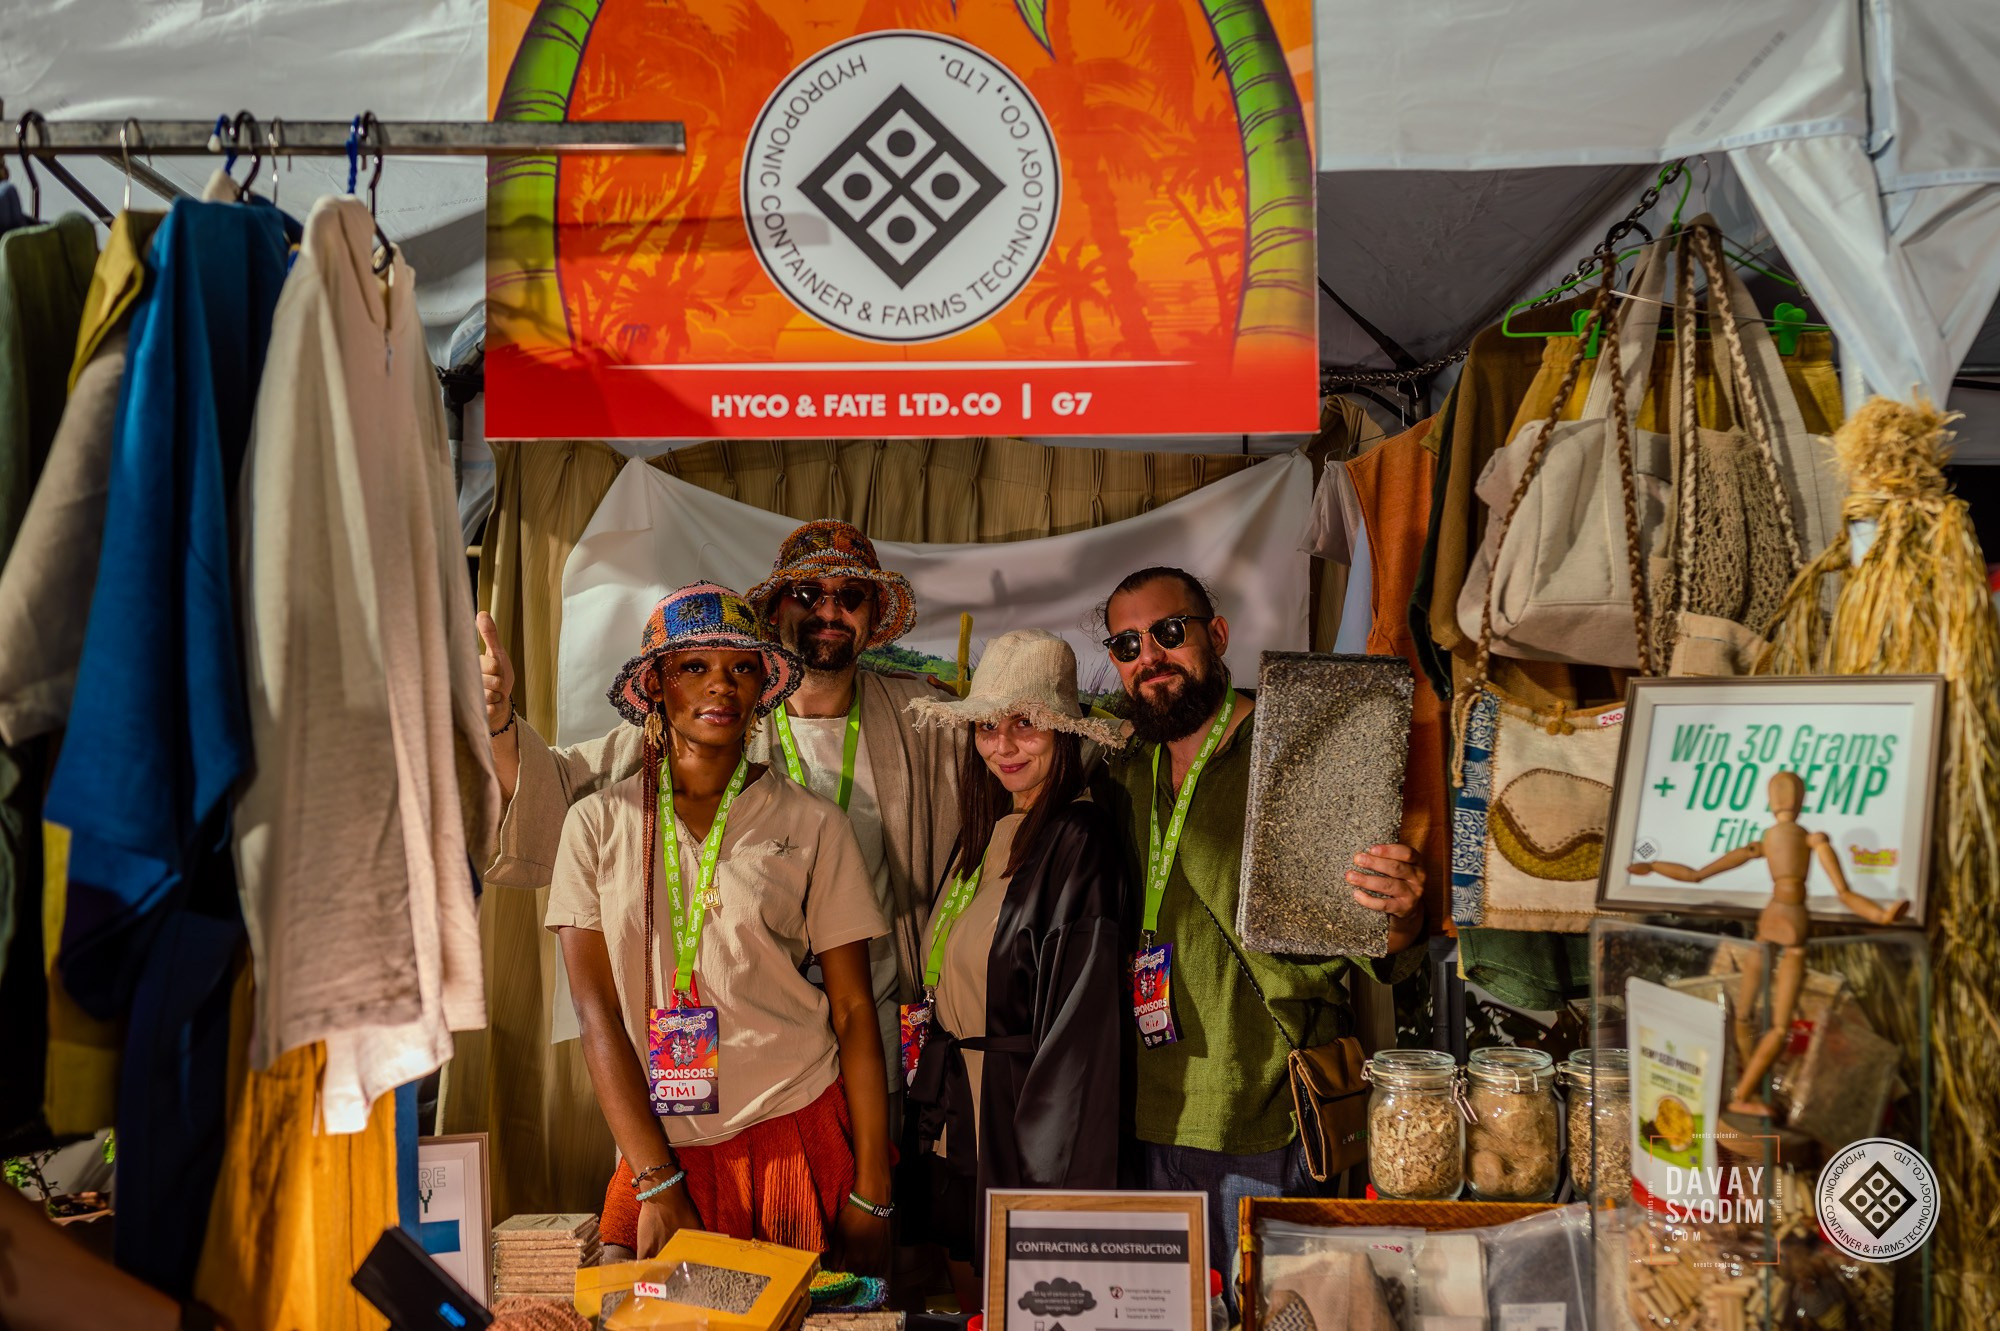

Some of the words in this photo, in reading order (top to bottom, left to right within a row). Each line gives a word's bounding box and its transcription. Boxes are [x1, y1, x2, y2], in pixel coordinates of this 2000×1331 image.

[940, 54, 990, 95] LTD.
[760, 55, 867, 188] HYDROPONIC
[996, 84, 1030, 139] CO.,
[966, 146, 1043, 301] TECHNOLOGY
[761, 195, 854, 314] CONTAINER
[858, 302, 872, 322] &
[881, 293, 967, 326] FARMS
[712, 394, 790, 417] HYCO
[796, 394, 817, 416] &
[824, 394, 886, 416] FATE
[1052, 392, 1092, 416] G7
[1670, 724, 1731, 763] Win
[1738, 724, 1782, 764] 30
[1789, 725, 1898, 766] Grams
[1686, 762, 1759, 811] 100
[1766, 764, 1888, 815] EMP
[1710, 818, 1767, 853] Filt
[1134, 998, 1166, 1016] SPONSORS
[651, 1068, 714, 1079] SPONSORS
[660, 1086, 695, 1097] JIMI
[1016, 1241, 1088, 1253] CONTRACTING
[1090, 1243, 1099, 1253] &
[1101, 1243, 1181, 1255] CONSTRUCTION
[638, 1281, 659, 1294] 1500
